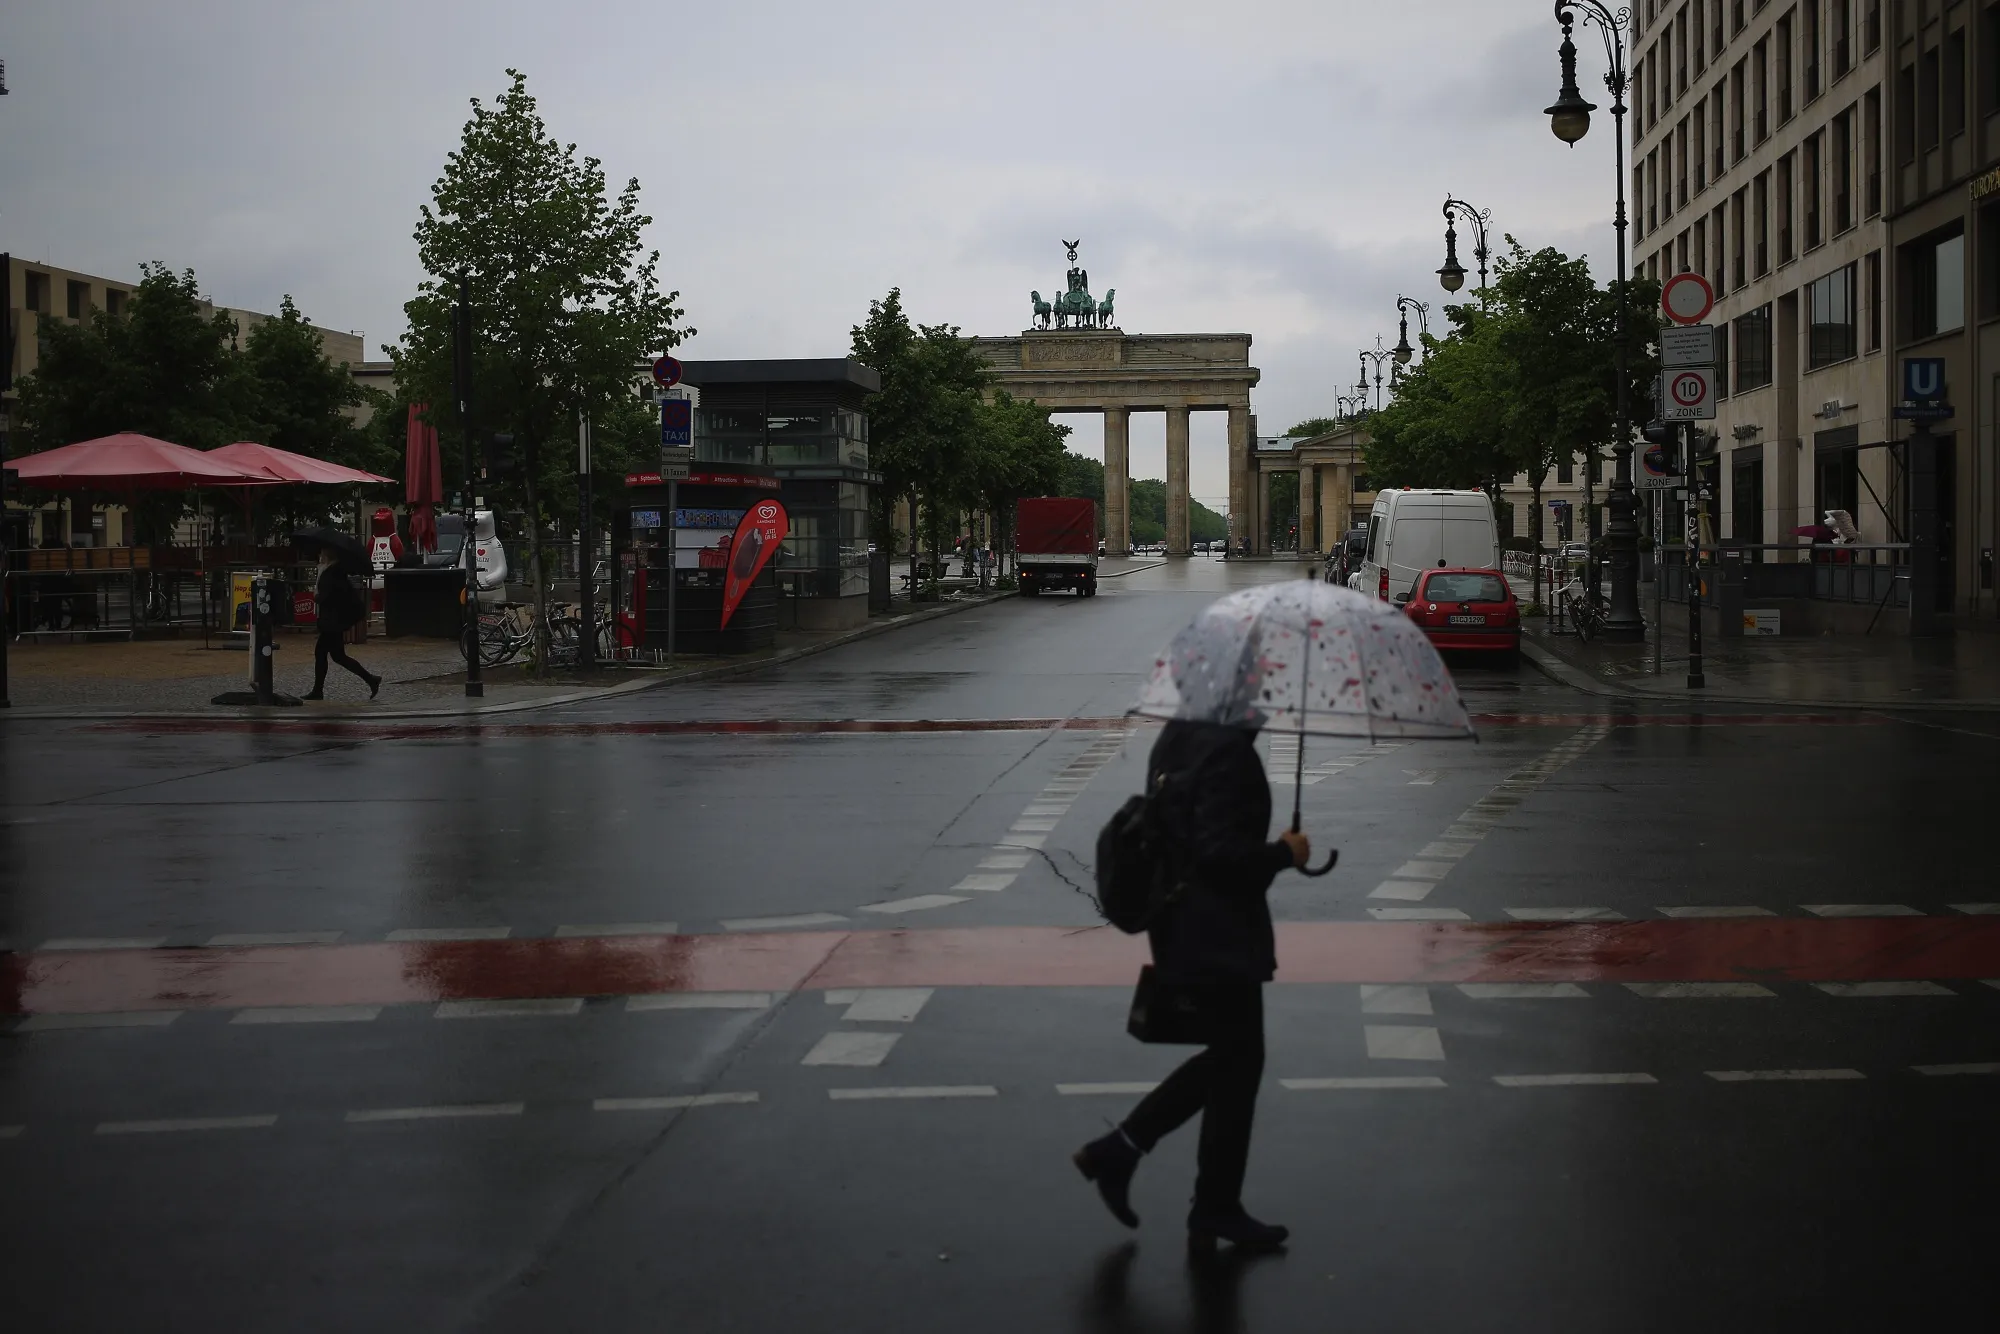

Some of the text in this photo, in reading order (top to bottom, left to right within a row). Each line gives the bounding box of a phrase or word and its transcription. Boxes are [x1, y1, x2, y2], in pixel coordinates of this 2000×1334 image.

[1911, 363, 1938, 395] U
[1680, 381, 1698, 397] 10
[1676, 408, 1703, 417] ZONE
[664, 430, 688, 441] TAXI
[663, 468, 669, 476] 11
[1646, 478, 1671, 487] ZONE
[234, 585, 246, 593] Hop
